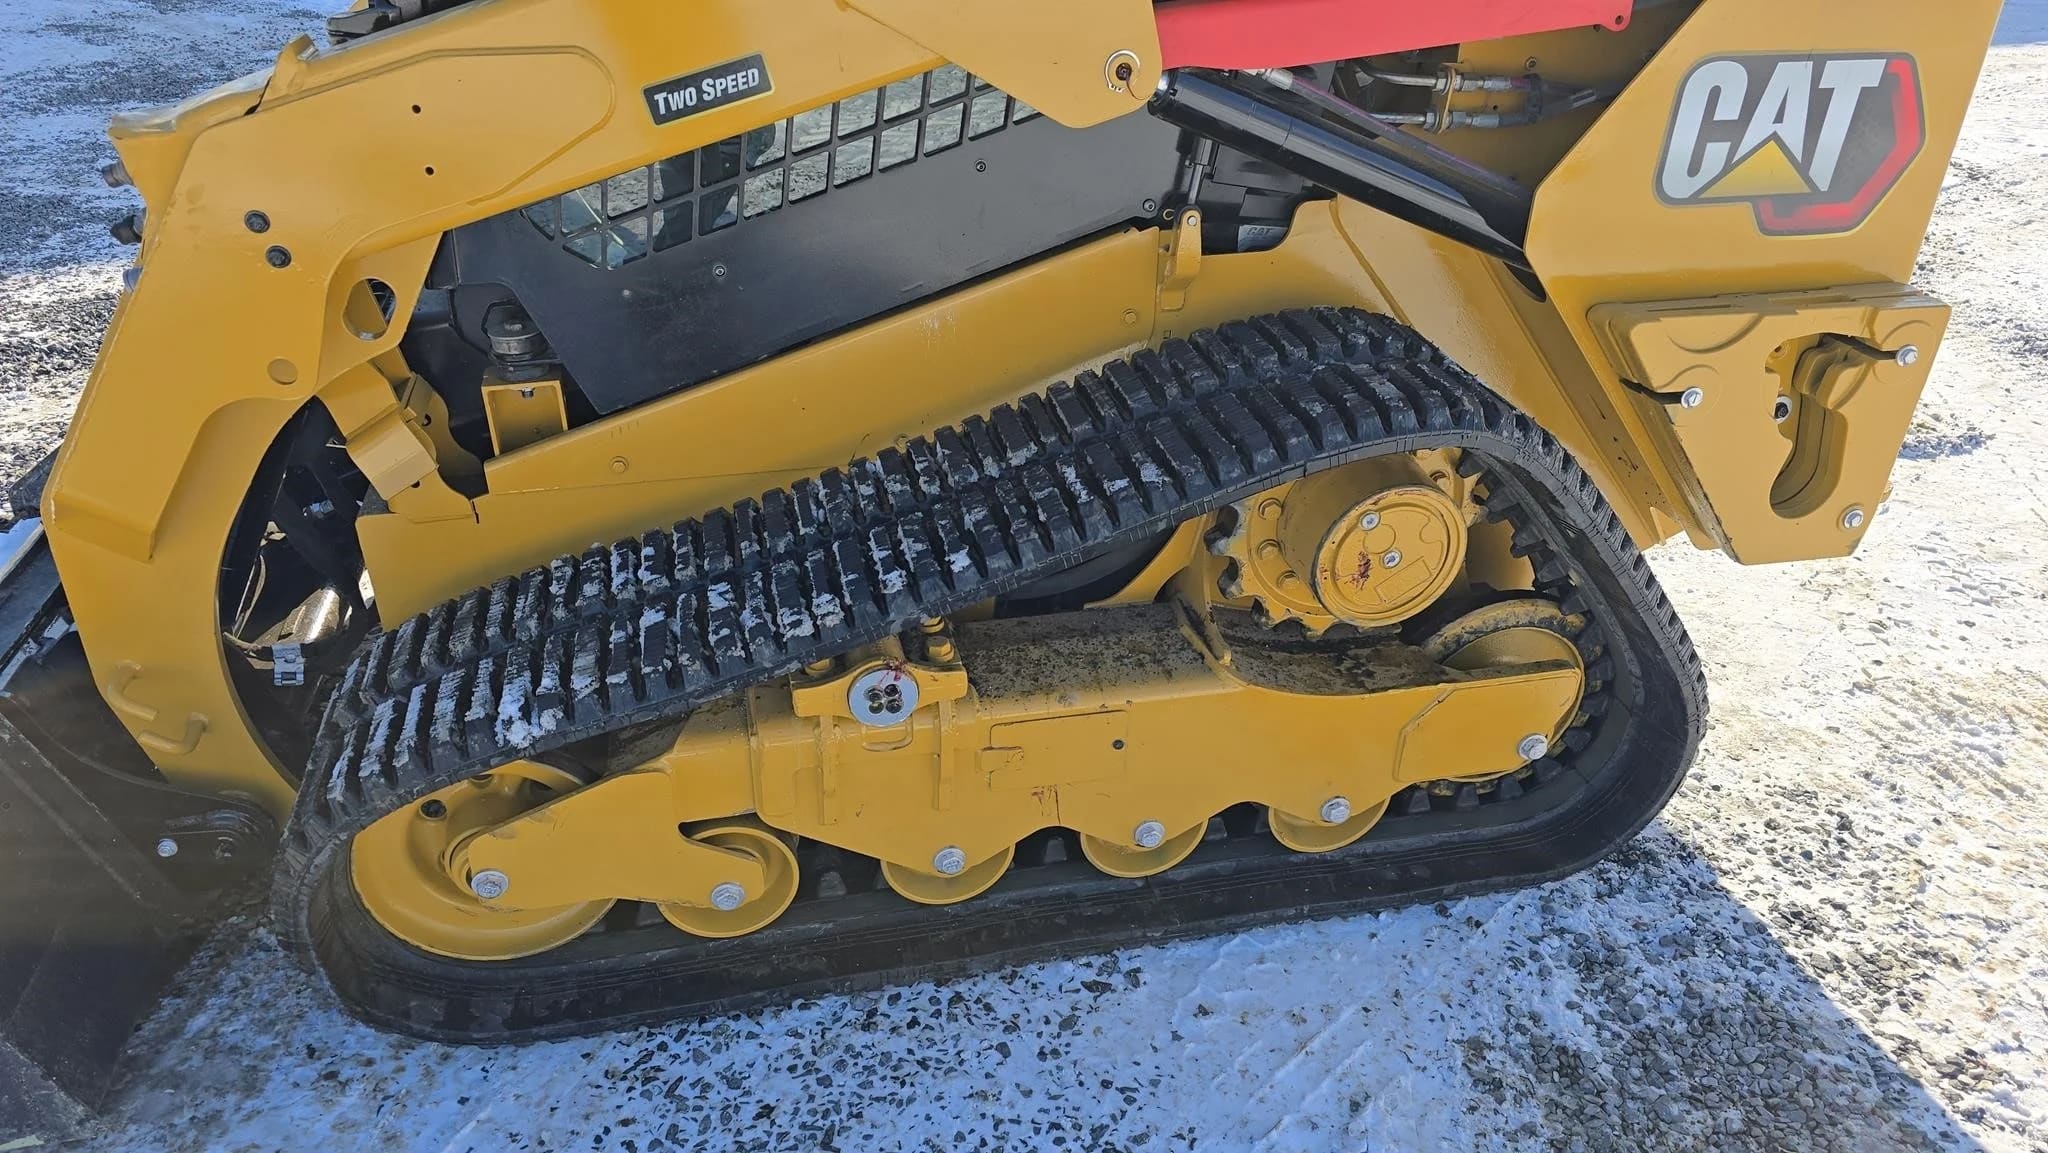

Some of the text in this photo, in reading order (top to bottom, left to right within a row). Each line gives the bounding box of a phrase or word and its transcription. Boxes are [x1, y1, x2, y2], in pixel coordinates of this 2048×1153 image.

[654, 68, 760, 115] TWO SPEED
[1662, 59, 1886, 199] CAT
